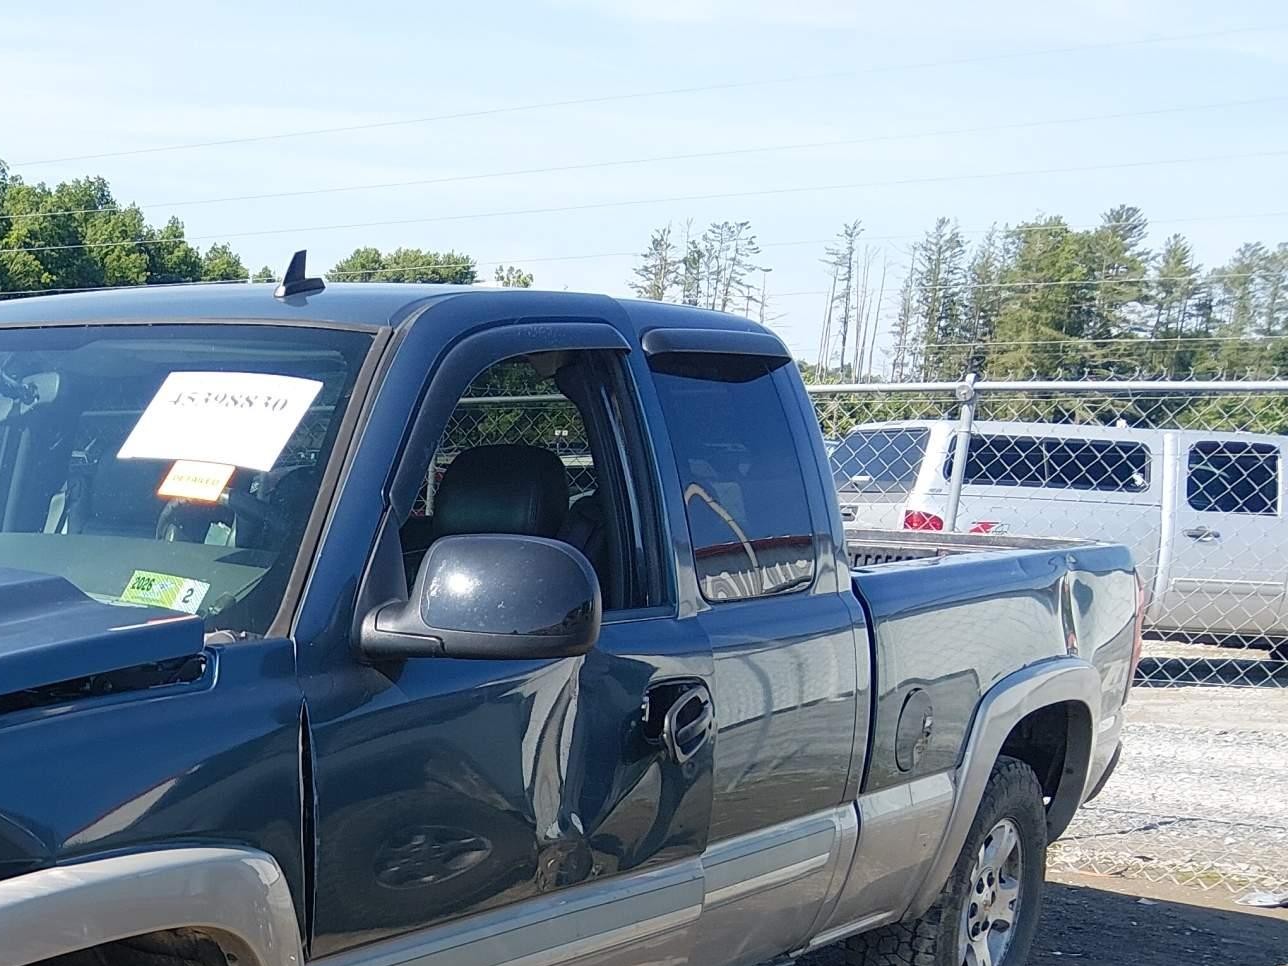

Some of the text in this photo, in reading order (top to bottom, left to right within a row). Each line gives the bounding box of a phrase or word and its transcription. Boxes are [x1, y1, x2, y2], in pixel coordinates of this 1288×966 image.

[169, 391, 288, 412] 45398830
[131, 576, 155, 591] 2026
[182, 588, 194, 603] 2
